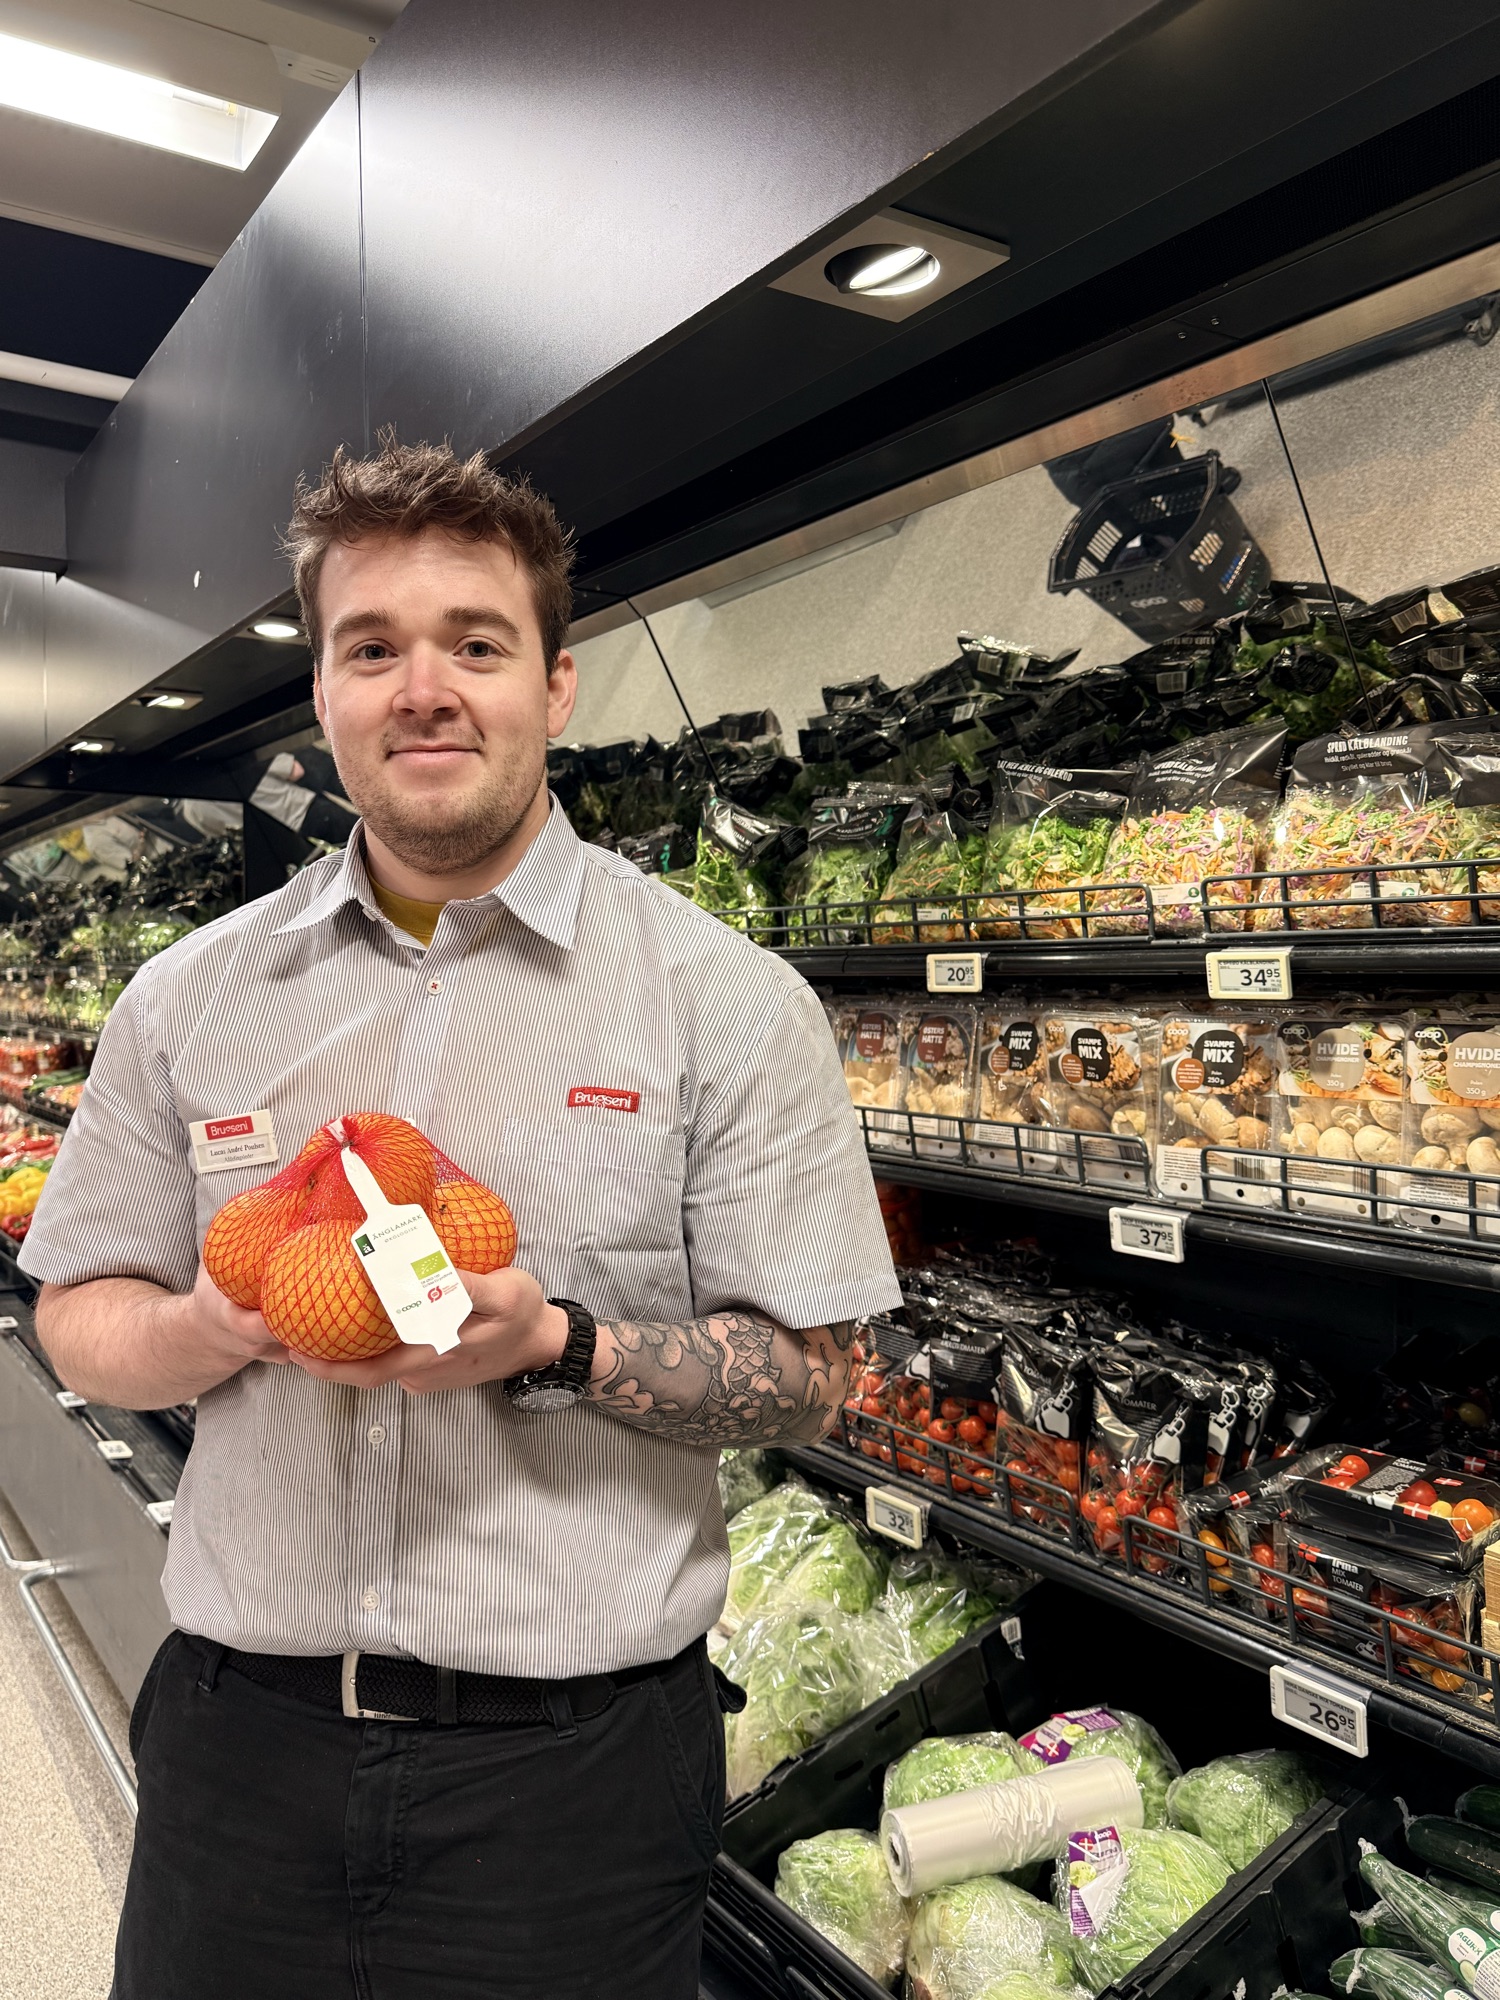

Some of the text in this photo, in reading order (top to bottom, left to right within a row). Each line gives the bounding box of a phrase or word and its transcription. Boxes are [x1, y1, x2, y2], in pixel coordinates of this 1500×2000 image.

[1348, 735, 1409, 752] KÅLBLANDING
[1010, 1030, 1033, 1038] SVAMPE
[1168, 1028, 1189, 1036] coop
[921, 1035, 944, 1044] HATTE
[1008, 1038, 1032, 1051] MIX
[1077, 1037, 1102, 1046] SVAMPE
[1204, 1040, 1235, 1048] SVAMPE
[1078, 1045, 1103, 1060] MIX
[1202, 1048, 1235, 1063] MIX
[1317, 1043, 1360, 1056] HVIDE
[1455, 1047, 1500, 1061] HVIDE
[1466, 1087, 1480, 1095] 350
[227, 1146, 243, 1154] André
[372, 1214, 423, 1240] ÄNGLAMARK
[384, 1226, 418, 1243] ØKOLOGISK
[402, 1300, 422, 1312] coop
[1332, 1559, 1358, 1574] Irma
[1332, 1567, 1346, 1577] MIX
[1332, 1575, 1364, 1592] TOMATER
